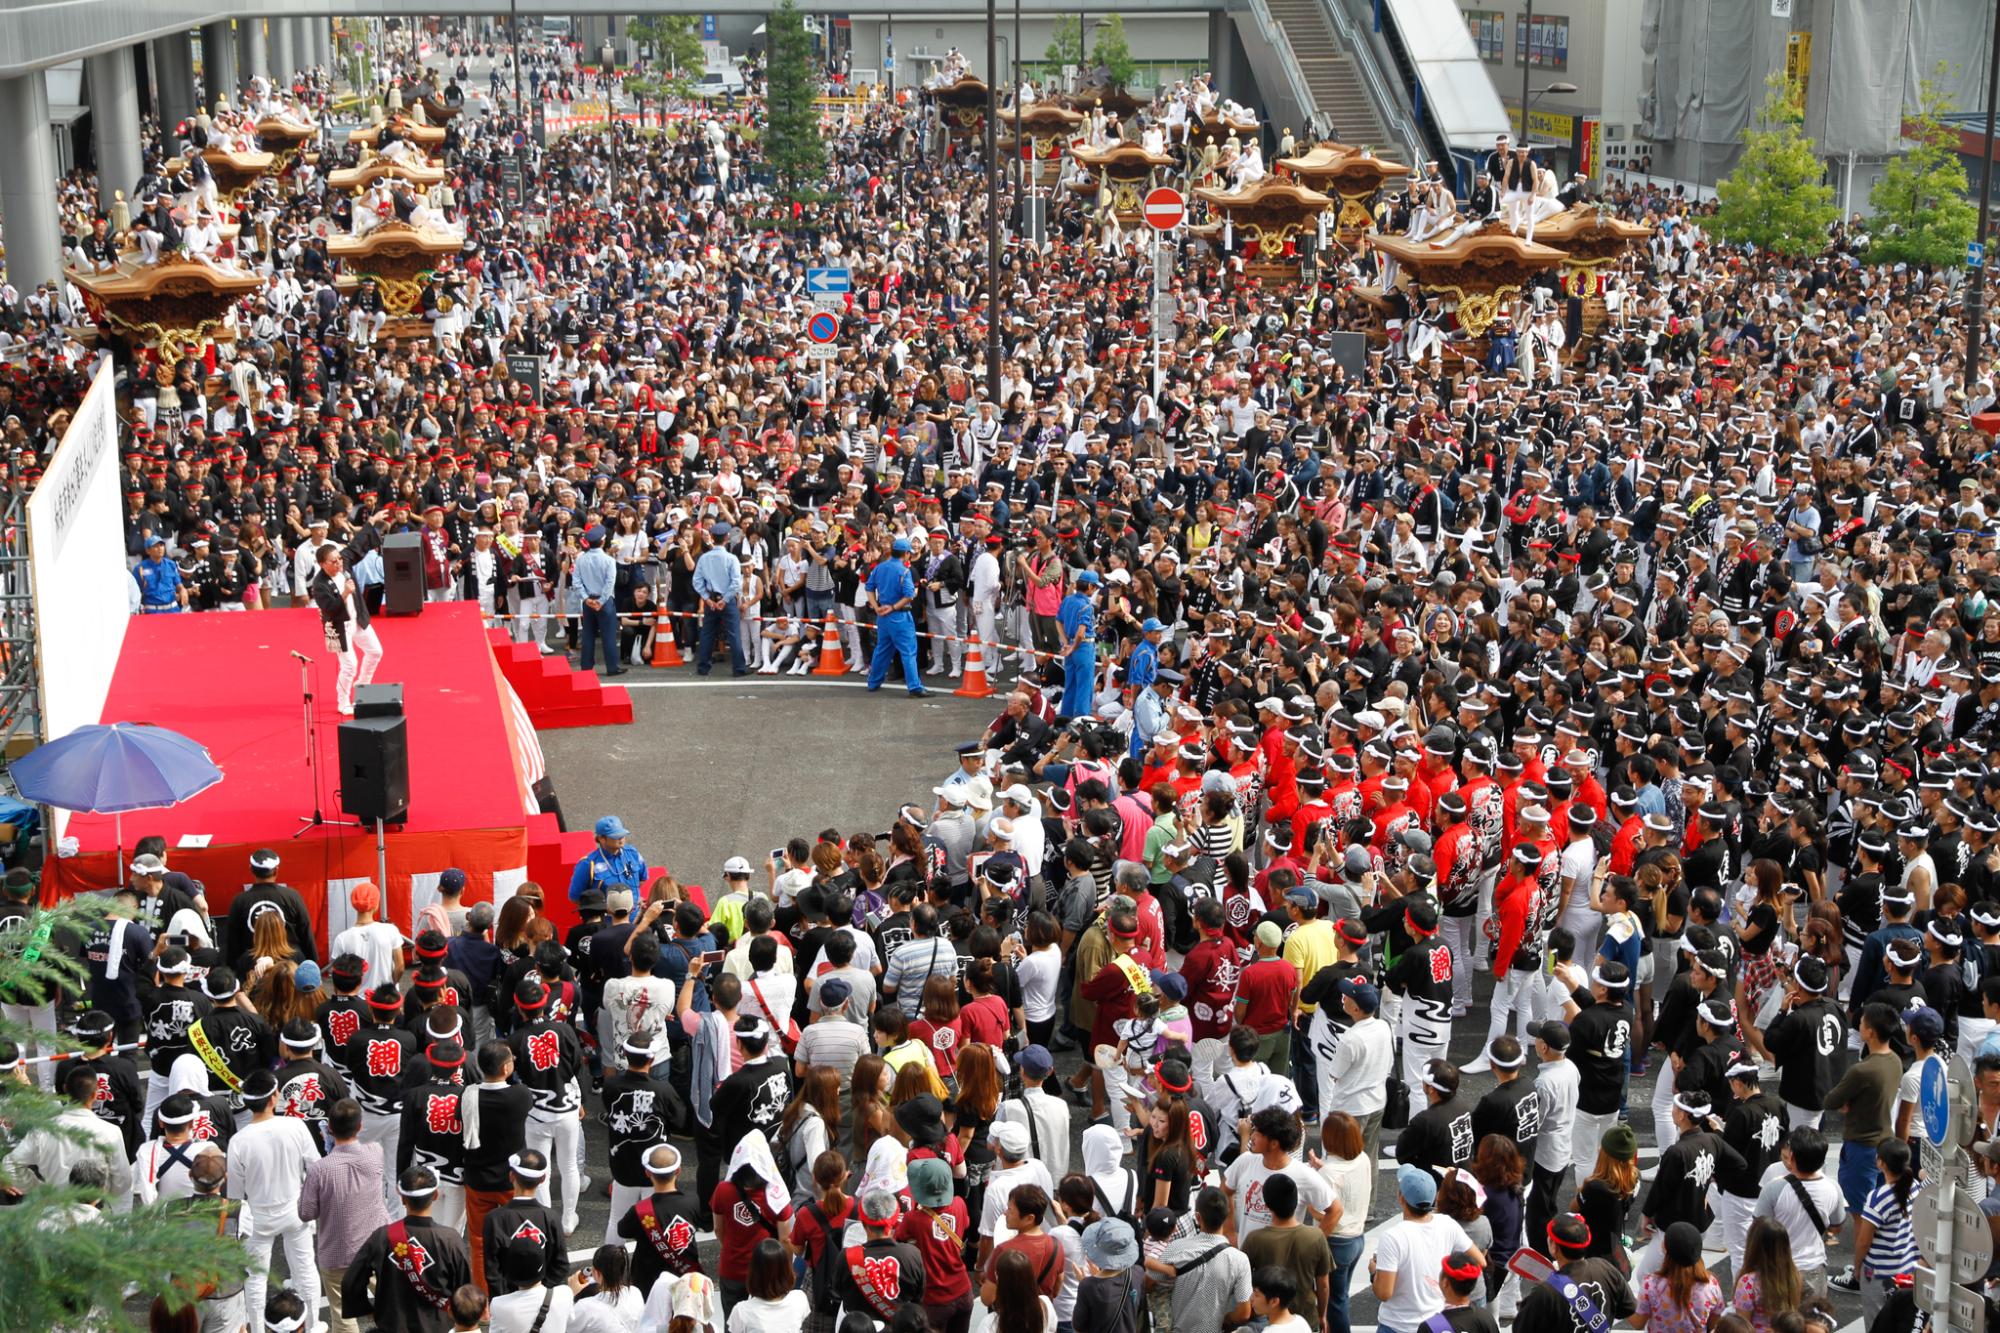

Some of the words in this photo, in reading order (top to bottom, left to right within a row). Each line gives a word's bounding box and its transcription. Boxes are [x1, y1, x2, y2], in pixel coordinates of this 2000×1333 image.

[810, 347, 837, 356] ここから
[300, 1077, 325, 1102] 春
[285, 1098, 305, 1119] 木
[192, 1116, 219, 1140] 春
